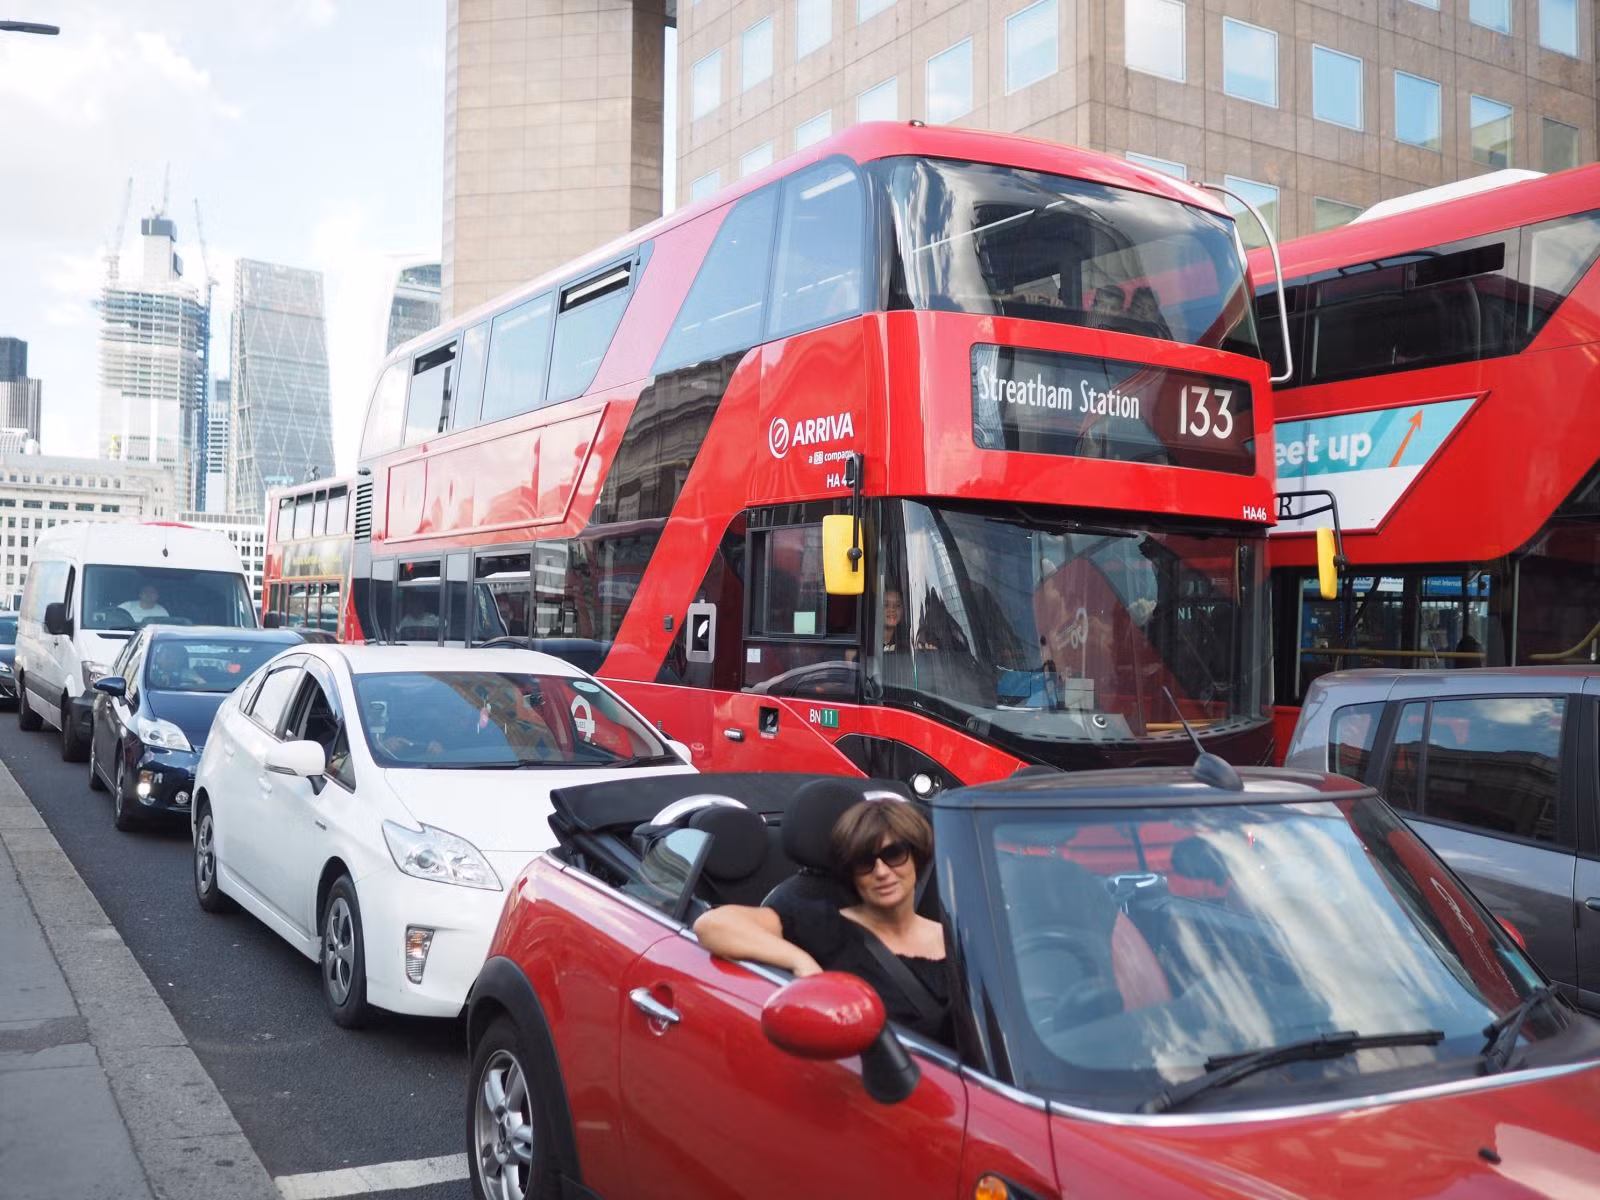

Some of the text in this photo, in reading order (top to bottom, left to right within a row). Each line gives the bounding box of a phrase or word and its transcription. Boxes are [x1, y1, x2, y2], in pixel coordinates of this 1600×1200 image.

[978, 365, 1140, 420] Streatham Station
[1179, 384, 1234, 440] 133
[791, 412, 854, 447] ARRIVA
[808, 455, 813, 464] a
[1275, 432, 1373, 467] eet up
[1242, 505, 1267, 521] HA46
[1279, 494, 1293, 516] R
[809, 708, 833, 724] BN 11
